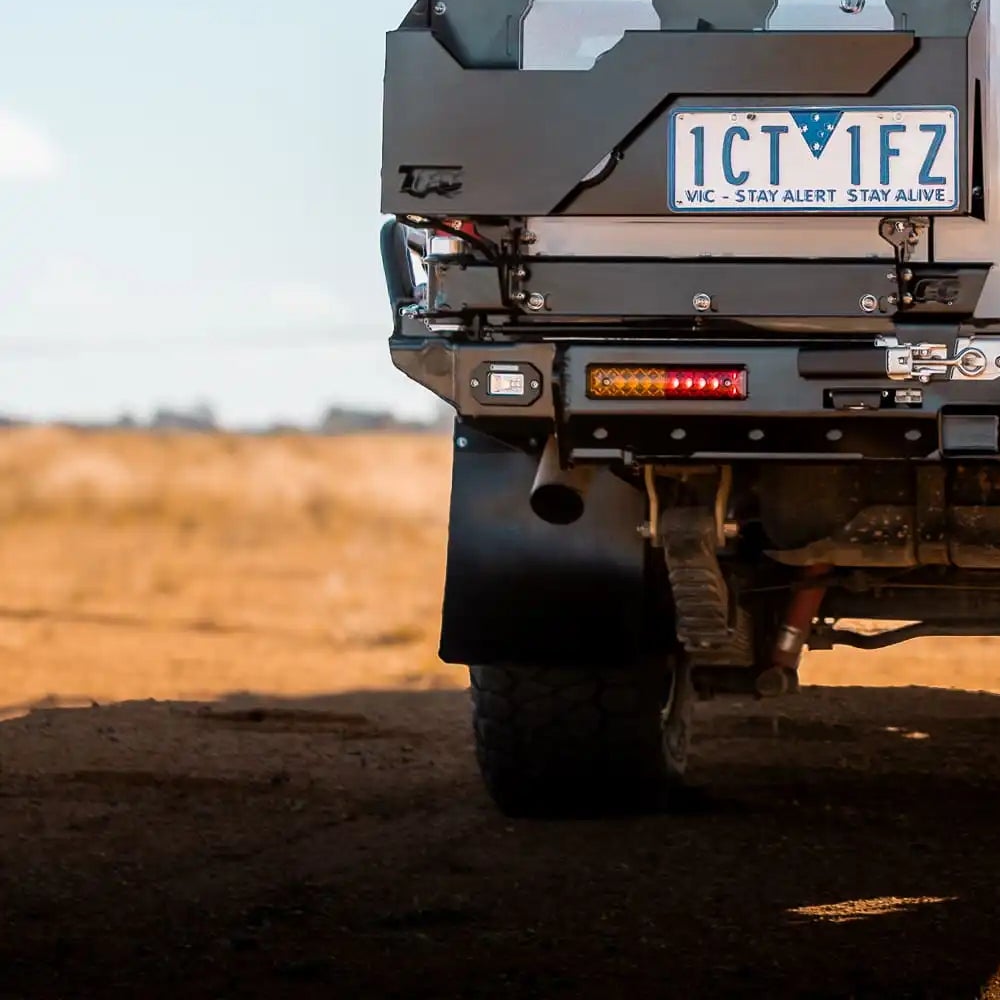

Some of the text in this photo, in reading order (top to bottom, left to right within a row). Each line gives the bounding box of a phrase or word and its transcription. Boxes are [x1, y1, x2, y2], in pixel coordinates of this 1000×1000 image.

[690, 124, 947, 187] 1CT 1FZ
[685, 190, 715, 204] VIC
[735, 190, 778, 204] STAY
[783, 189, 836, 204] ALERT
[847, 189, 891, 204] STAY
[895, 188, 945, 203] ALIVE
